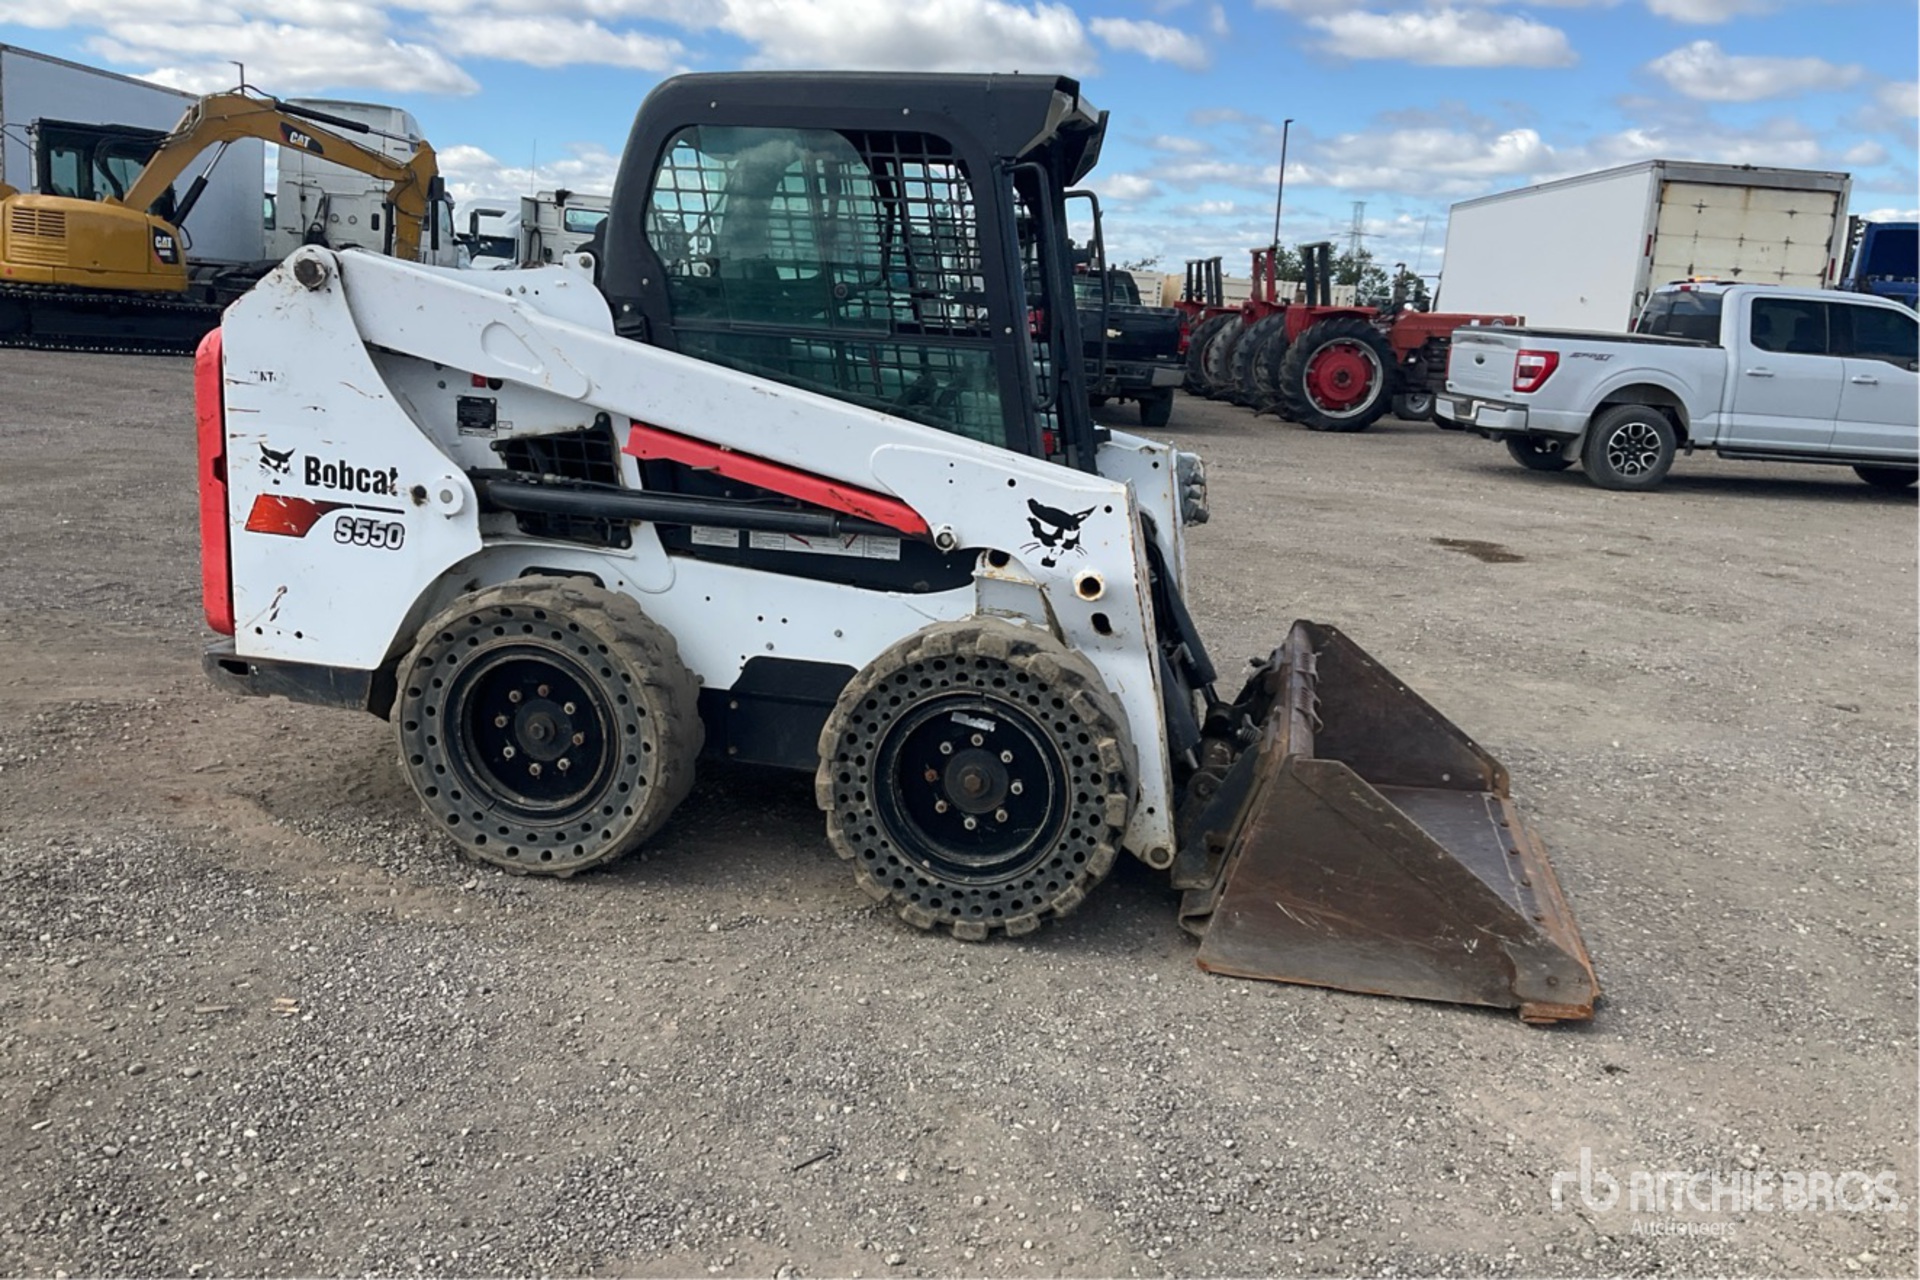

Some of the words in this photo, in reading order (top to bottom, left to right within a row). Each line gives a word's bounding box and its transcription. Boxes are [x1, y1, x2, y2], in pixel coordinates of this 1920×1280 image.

[289, 131, 311, 148] CAT
[154, 235, 172, 249] CAT
[304, 455, 398, 497] Bobcat
[334, 515, 405, 551] S550
